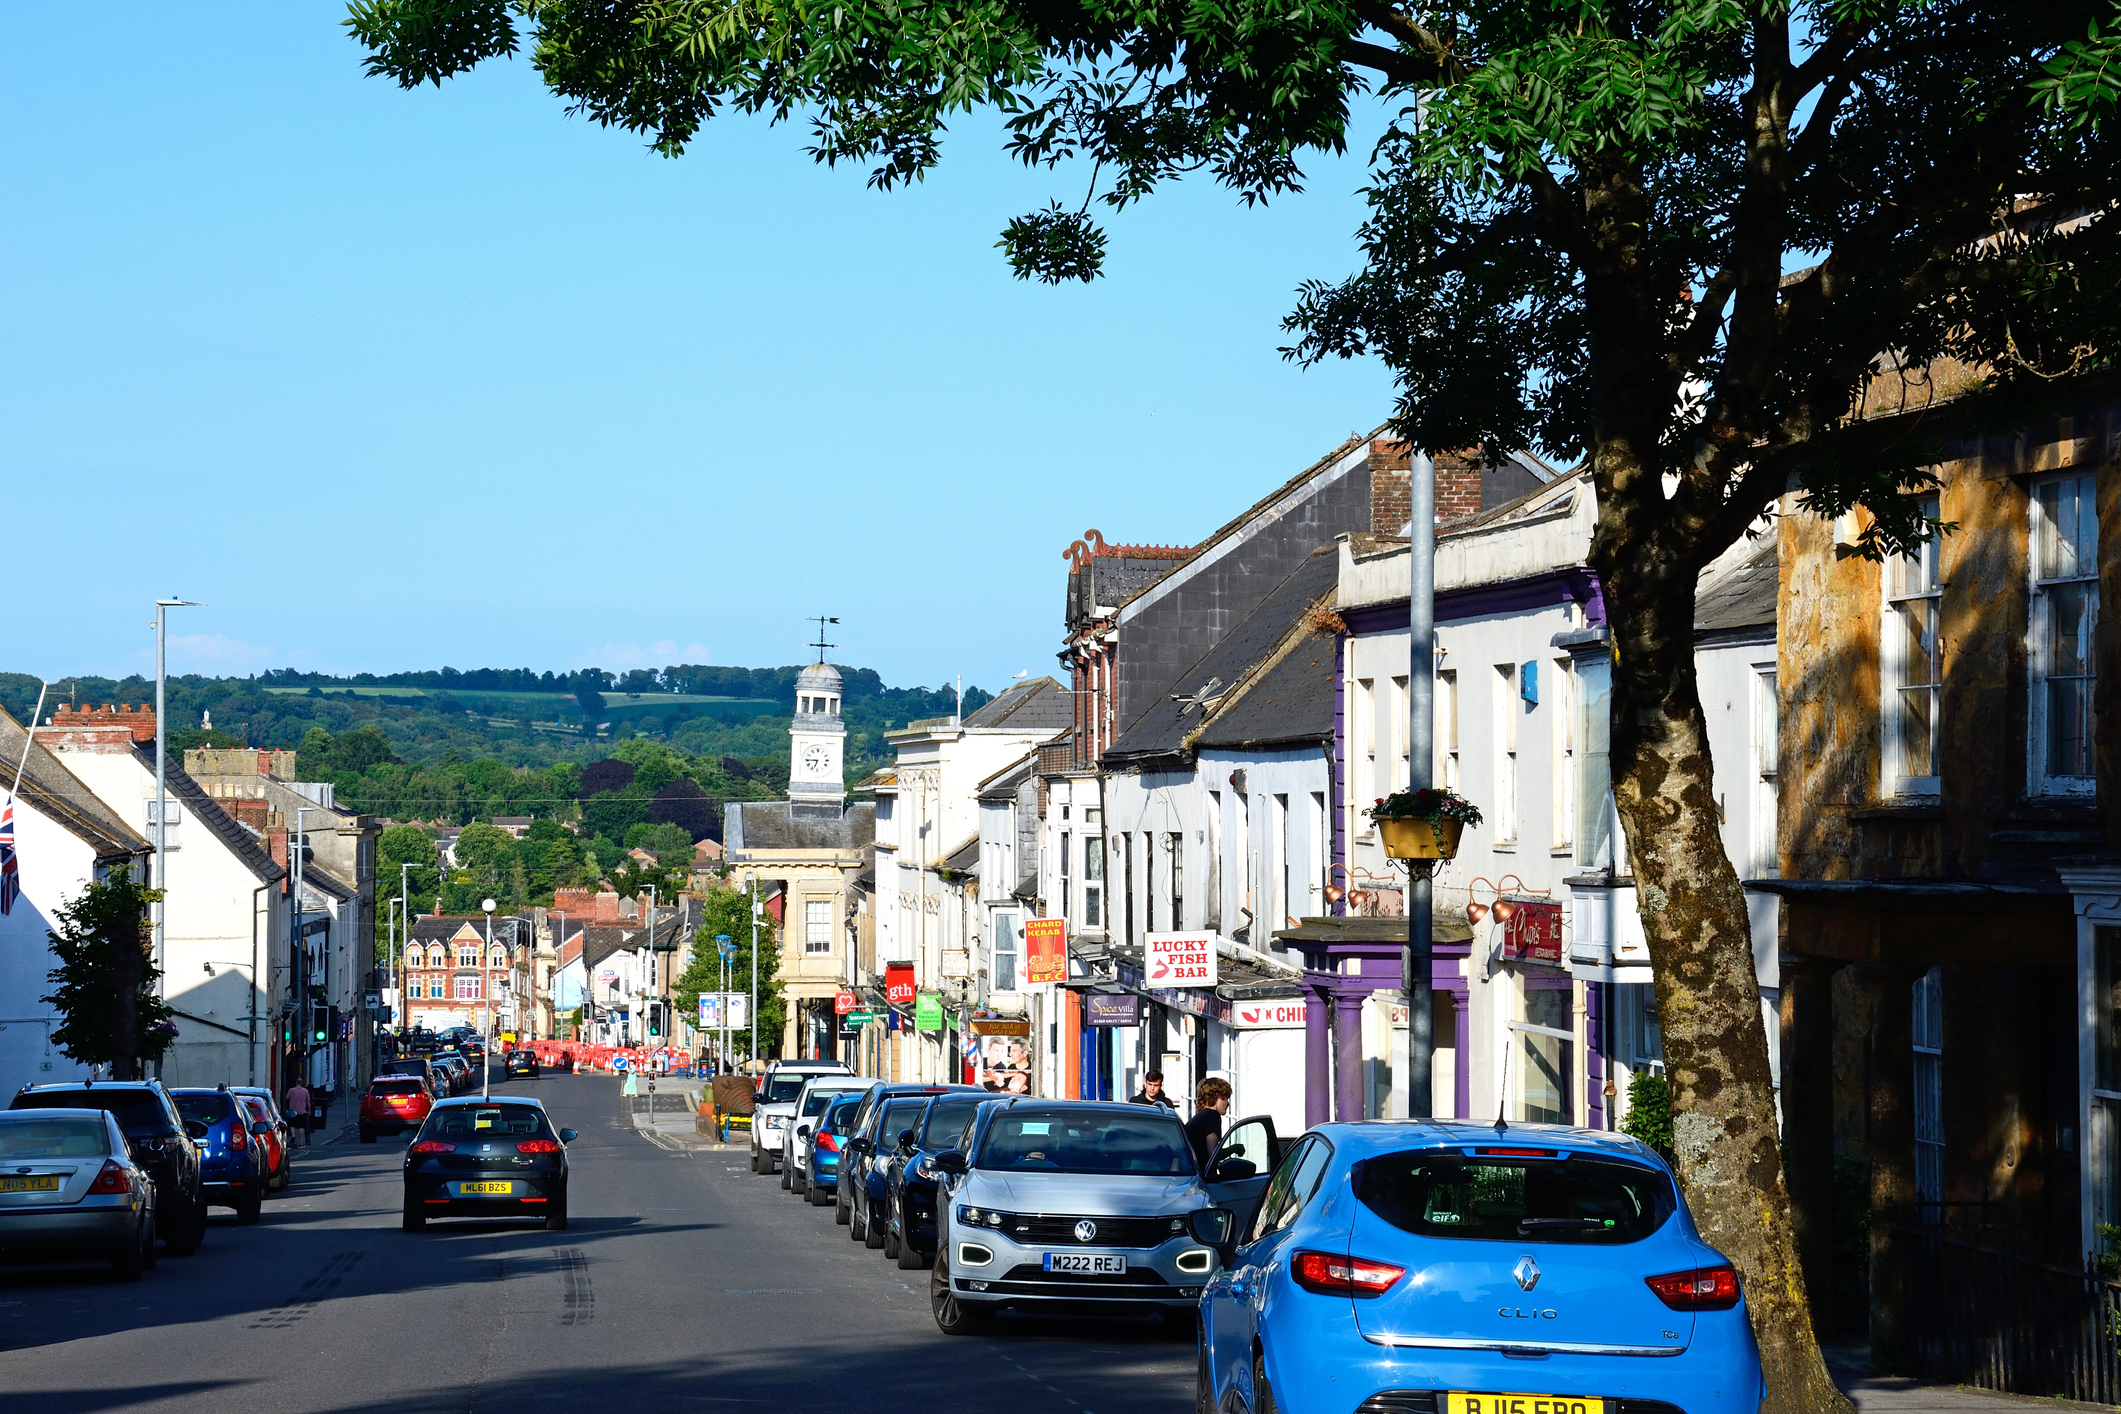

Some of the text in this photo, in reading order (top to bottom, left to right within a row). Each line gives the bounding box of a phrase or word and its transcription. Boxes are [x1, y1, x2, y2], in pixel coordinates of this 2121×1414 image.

[1153, 940, 1208, 952] LUCKY
[1168, 953, 1208, 964] FISH
[1032, 973, 1063, 982] B.F.C
[1175, 967, 1208, 978] BAR
[889, 983, 912, 1000] gth
[1091, 998, 1134, 1016] Spice Villa
[0, 1177, 53, 1190] N05 YLA
[466, 1183, 506, 1192] ML61 BZS
[1052, 1256, 1122, 1271] M222 REJ
[1498, 1308, 1558, 1319] CLIO
